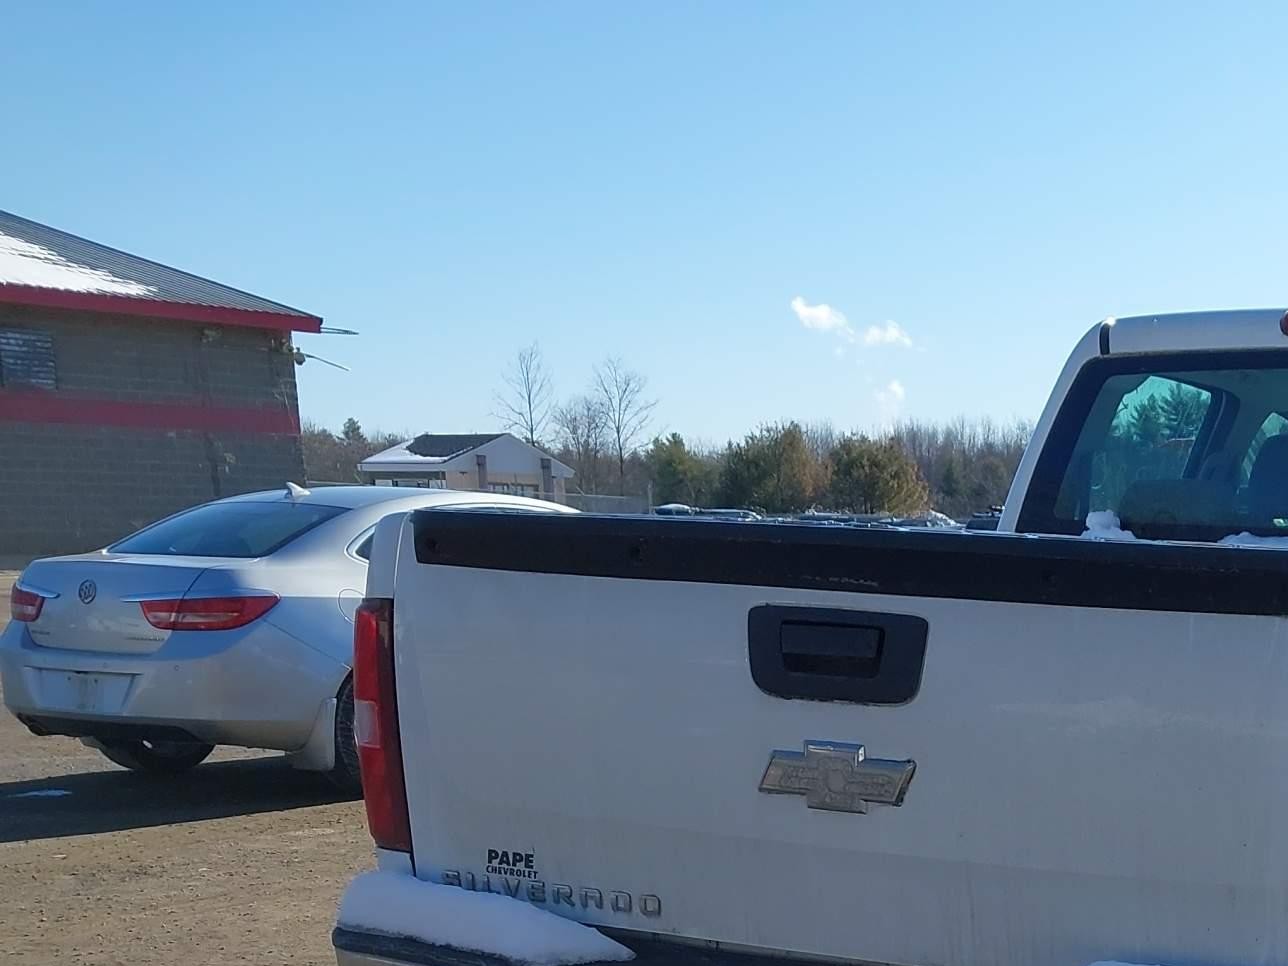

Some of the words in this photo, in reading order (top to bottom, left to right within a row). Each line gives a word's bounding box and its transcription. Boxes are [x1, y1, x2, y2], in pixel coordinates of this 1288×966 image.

[487, 849, 534, 869] PAPE
[486, 865, 538, 879] CHEVROLET
[441, 869, 662, 918] SILVERADO
